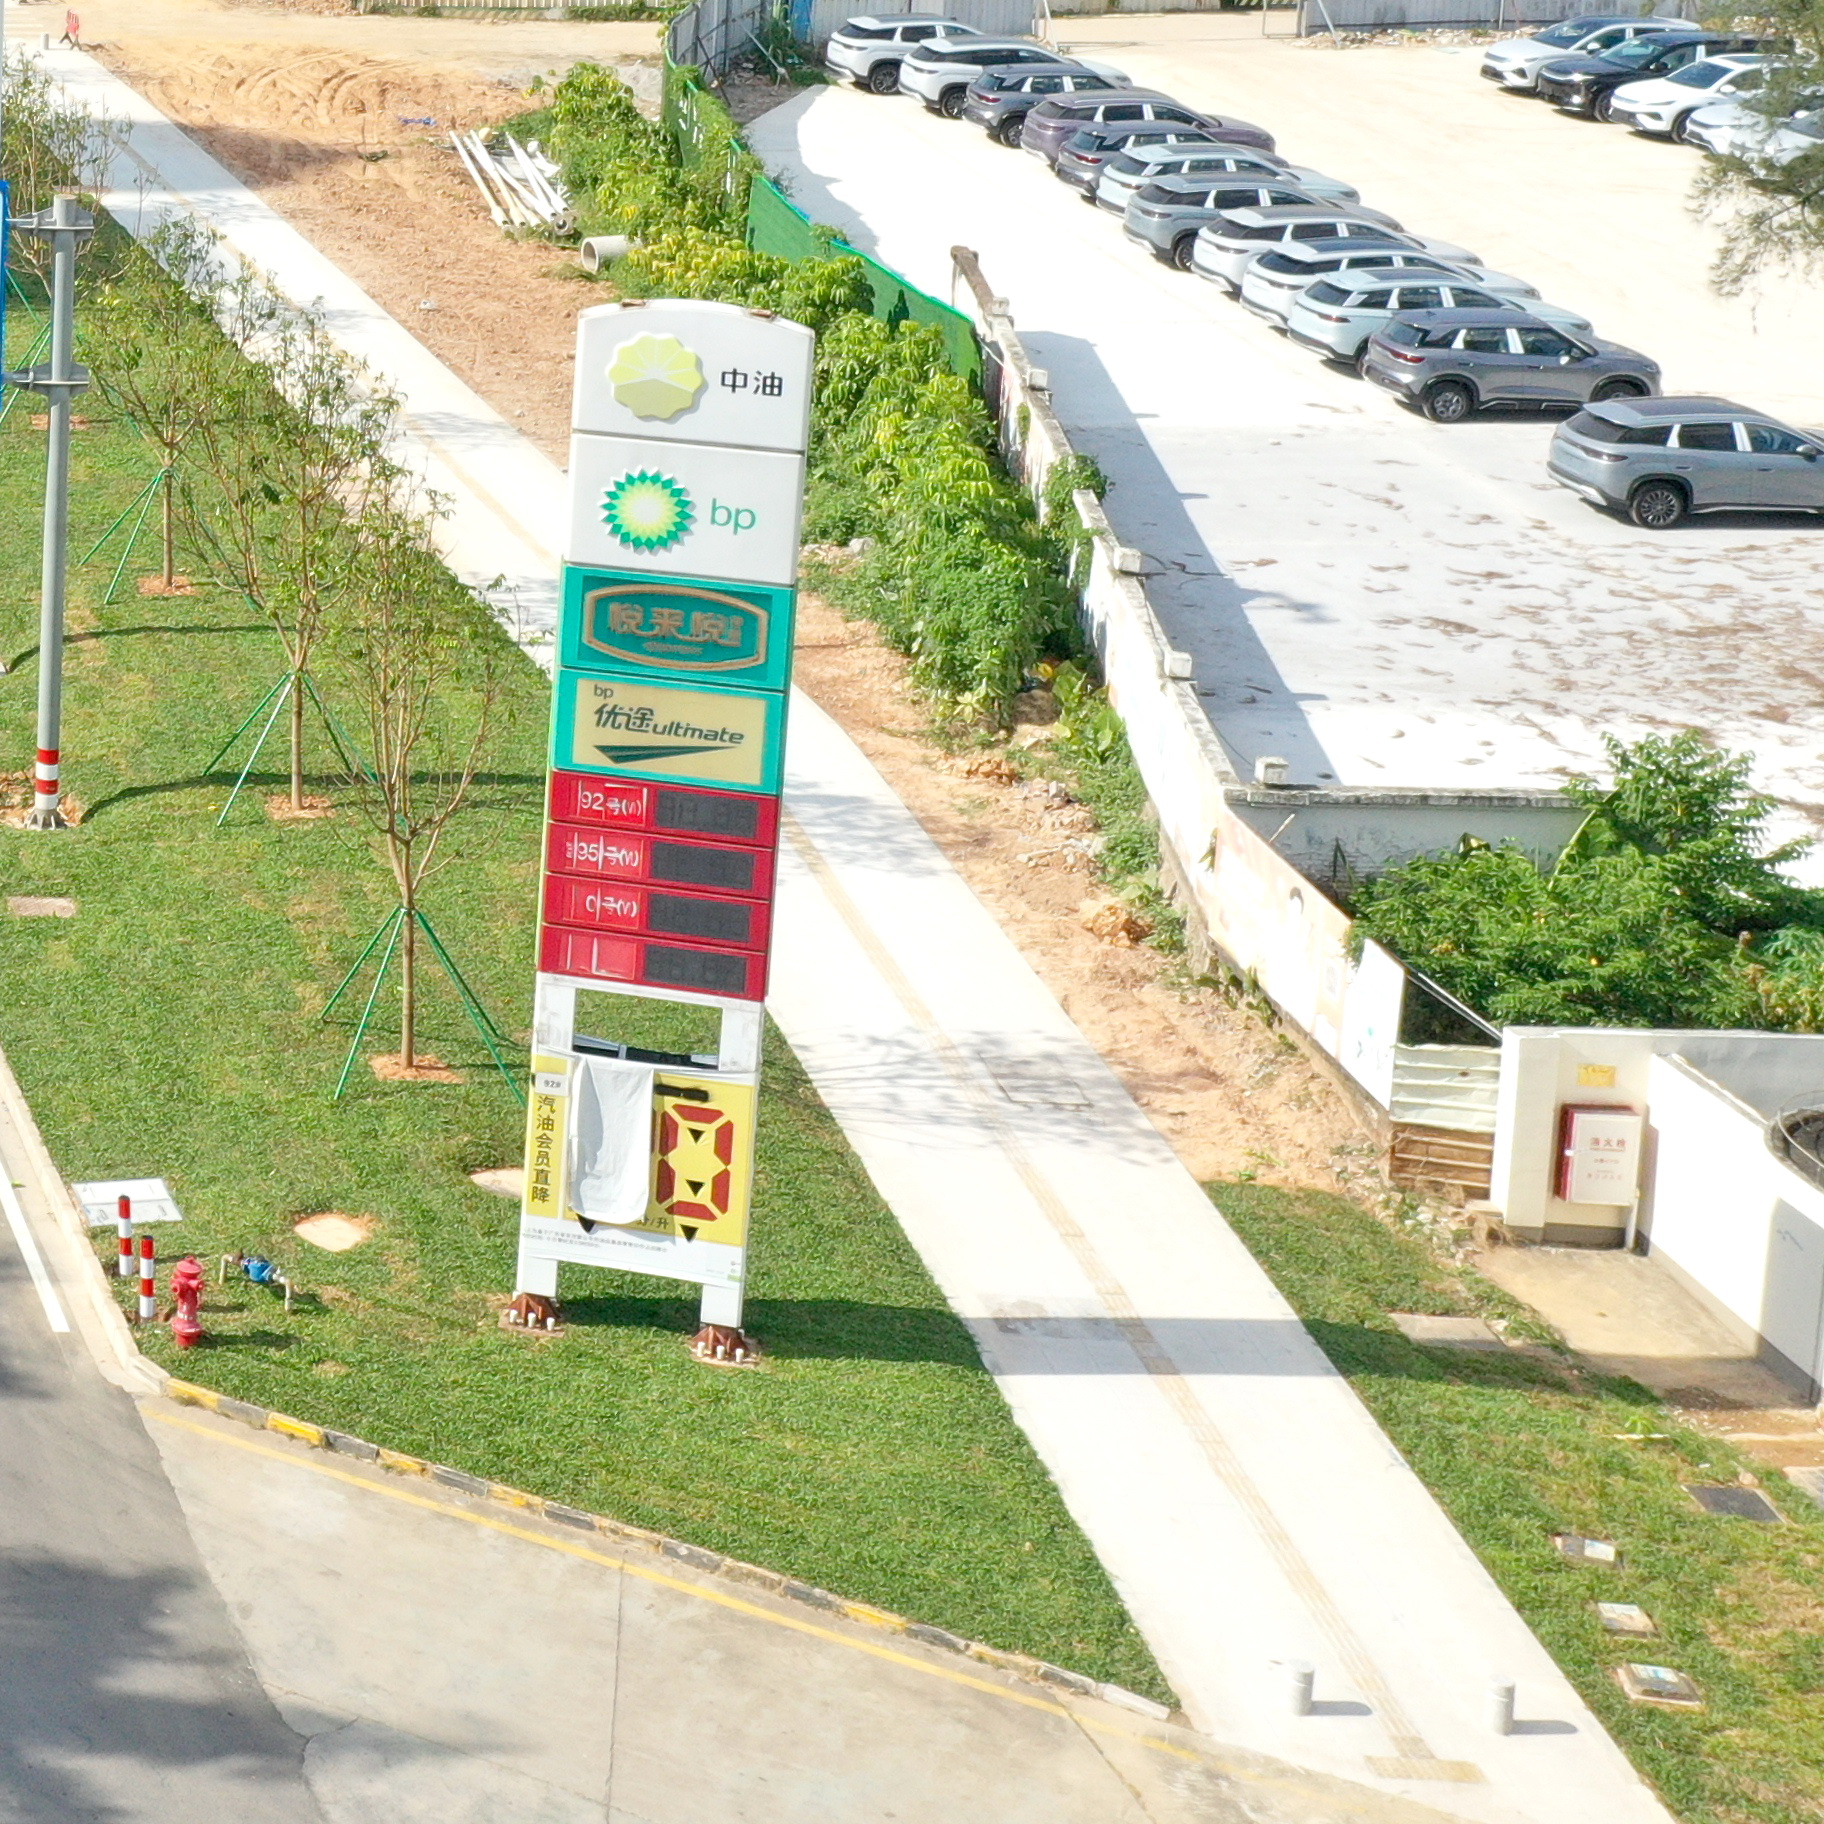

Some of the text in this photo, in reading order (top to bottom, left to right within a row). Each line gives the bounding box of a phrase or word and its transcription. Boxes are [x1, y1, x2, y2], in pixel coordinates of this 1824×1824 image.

[721, 368, 783, 398] 中油
[710, 498, 757, 536] bp
[594, 684, 614, 699] bp
[531, 1095, 555, 1205] 汽油会员直降
